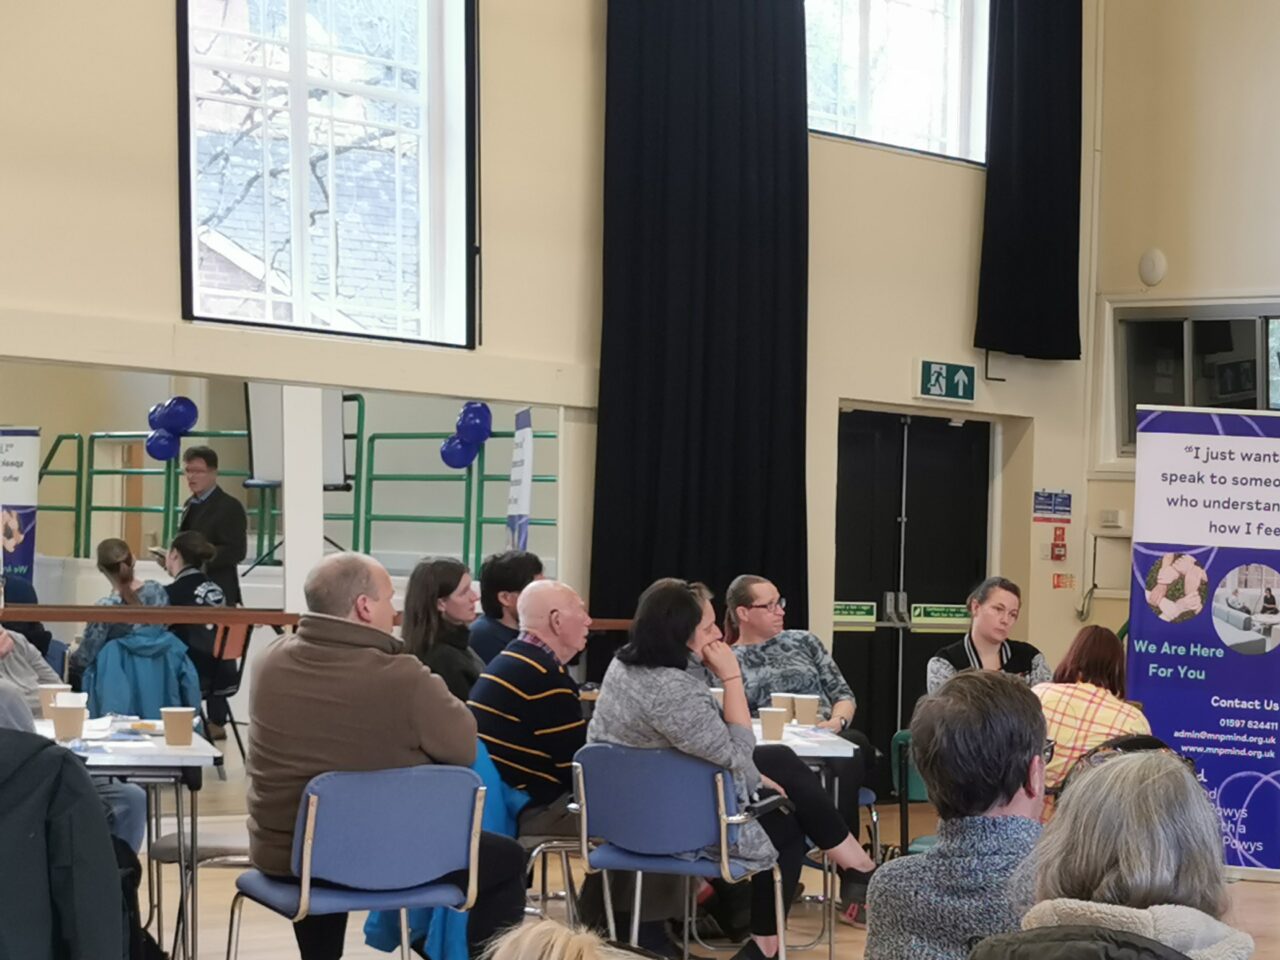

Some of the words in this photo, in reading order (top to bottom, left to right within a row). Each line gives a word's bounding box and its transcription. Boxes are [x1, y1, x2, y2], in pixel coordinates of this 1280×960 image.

[1202, 447, 1235, 463] just
[1240, 450, 1280, 464] want
[1161, 471, 1205, 485] speak
[1210, 473, 1227, 485] to
[1166, 495, 1199, 508] who
[1209, 521, 1241, 534] how
[1245, 522, 1252, 535] I
[1134, 639, 1157, 653] We
[1161, 641, 1186, 655] Are
[1190, 643, 1224, 657] Here
[1149, 663, 1173, 677] For
[1178, 665, 1206, 680] You
[1211, 695, 1261, 710] Contact
[1264, 699, 1280, 711] Us
[1219, 718, 1246, 728] 01597
[1173, 730, 1276, 745] admin@mnpmind.org.uk
[1181, 745, 1275, 759] www.mnpmind.org.uk
